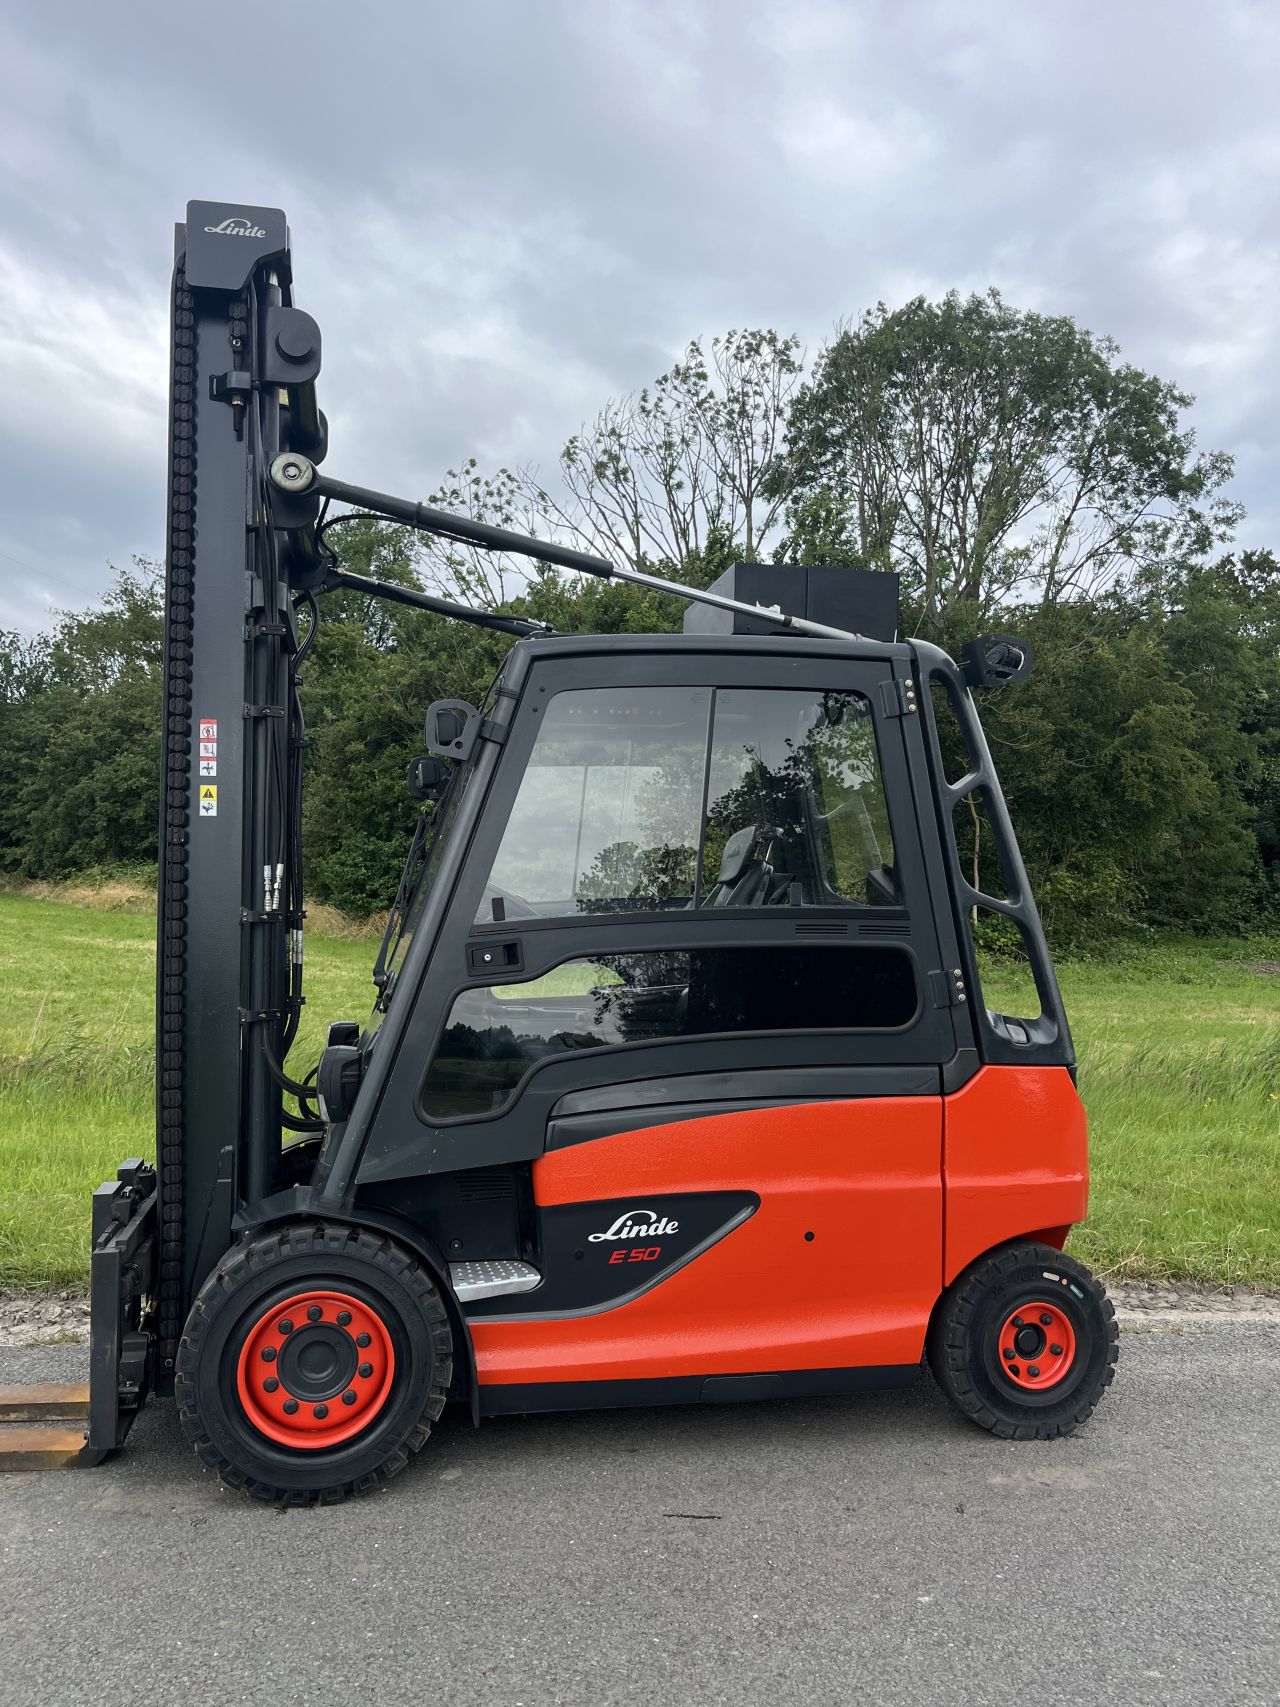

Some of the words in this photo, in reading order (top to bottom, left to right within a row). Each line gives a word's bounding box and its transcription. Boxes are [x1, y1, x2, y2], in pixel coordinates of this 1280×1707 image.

[204, 218, 266, 238] Linde
[588, 1210, 679, 1242] Linde
[609, 1250, 628, 1264] E
[628, 1247, 661, 1262] 50
